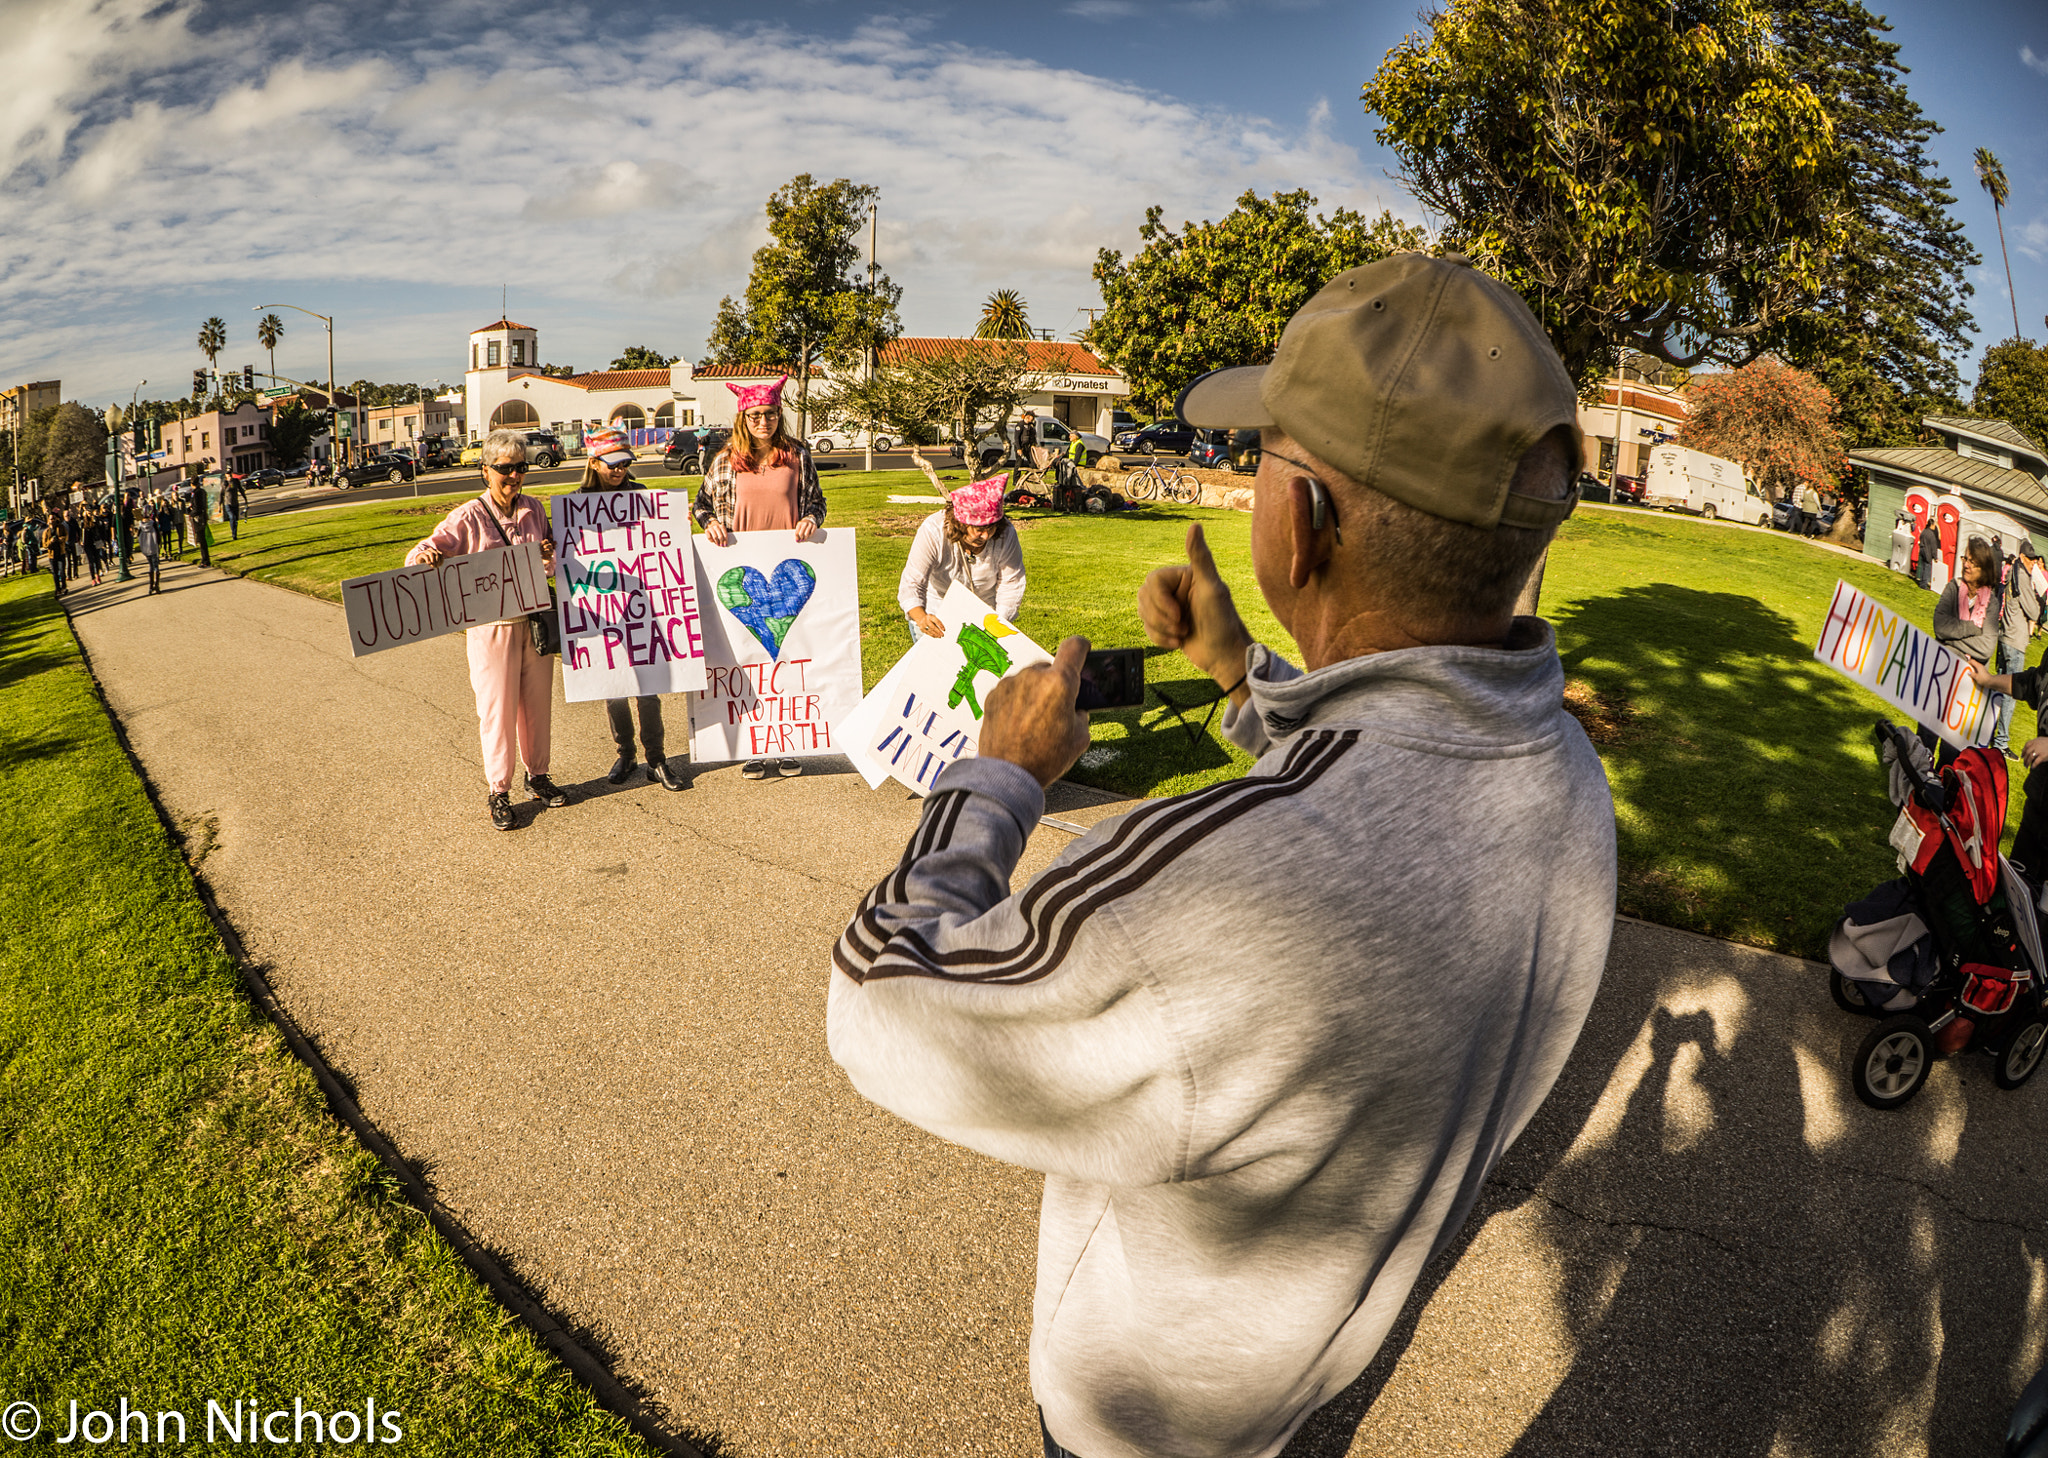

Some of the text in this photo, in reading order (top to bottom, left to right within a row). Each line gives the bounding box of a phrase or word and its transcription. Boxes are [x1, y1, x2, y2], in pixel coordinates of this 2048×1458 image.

[1064, 378, 1108, 390] Dynatest
[563, 492, 669, 527] IMAGINE
[561, 521, 671, 558] ALL The
[563, 548, 685, 598] WOMEN
[350, 546, 550, 646] JUSTICE FOR ALL
[563, 586, 696, 634] LIVING LIFE
[568, 614, 704, 670] In PEACE
[1819, 581, 1928, 706] HUMAN
[728, 695, 821, 724] MOTHER
[903, 693, 978, 759] WE AR
[750, 721, 830, 754] EARTH
[1994, 926, 2009, 937] Jeep
